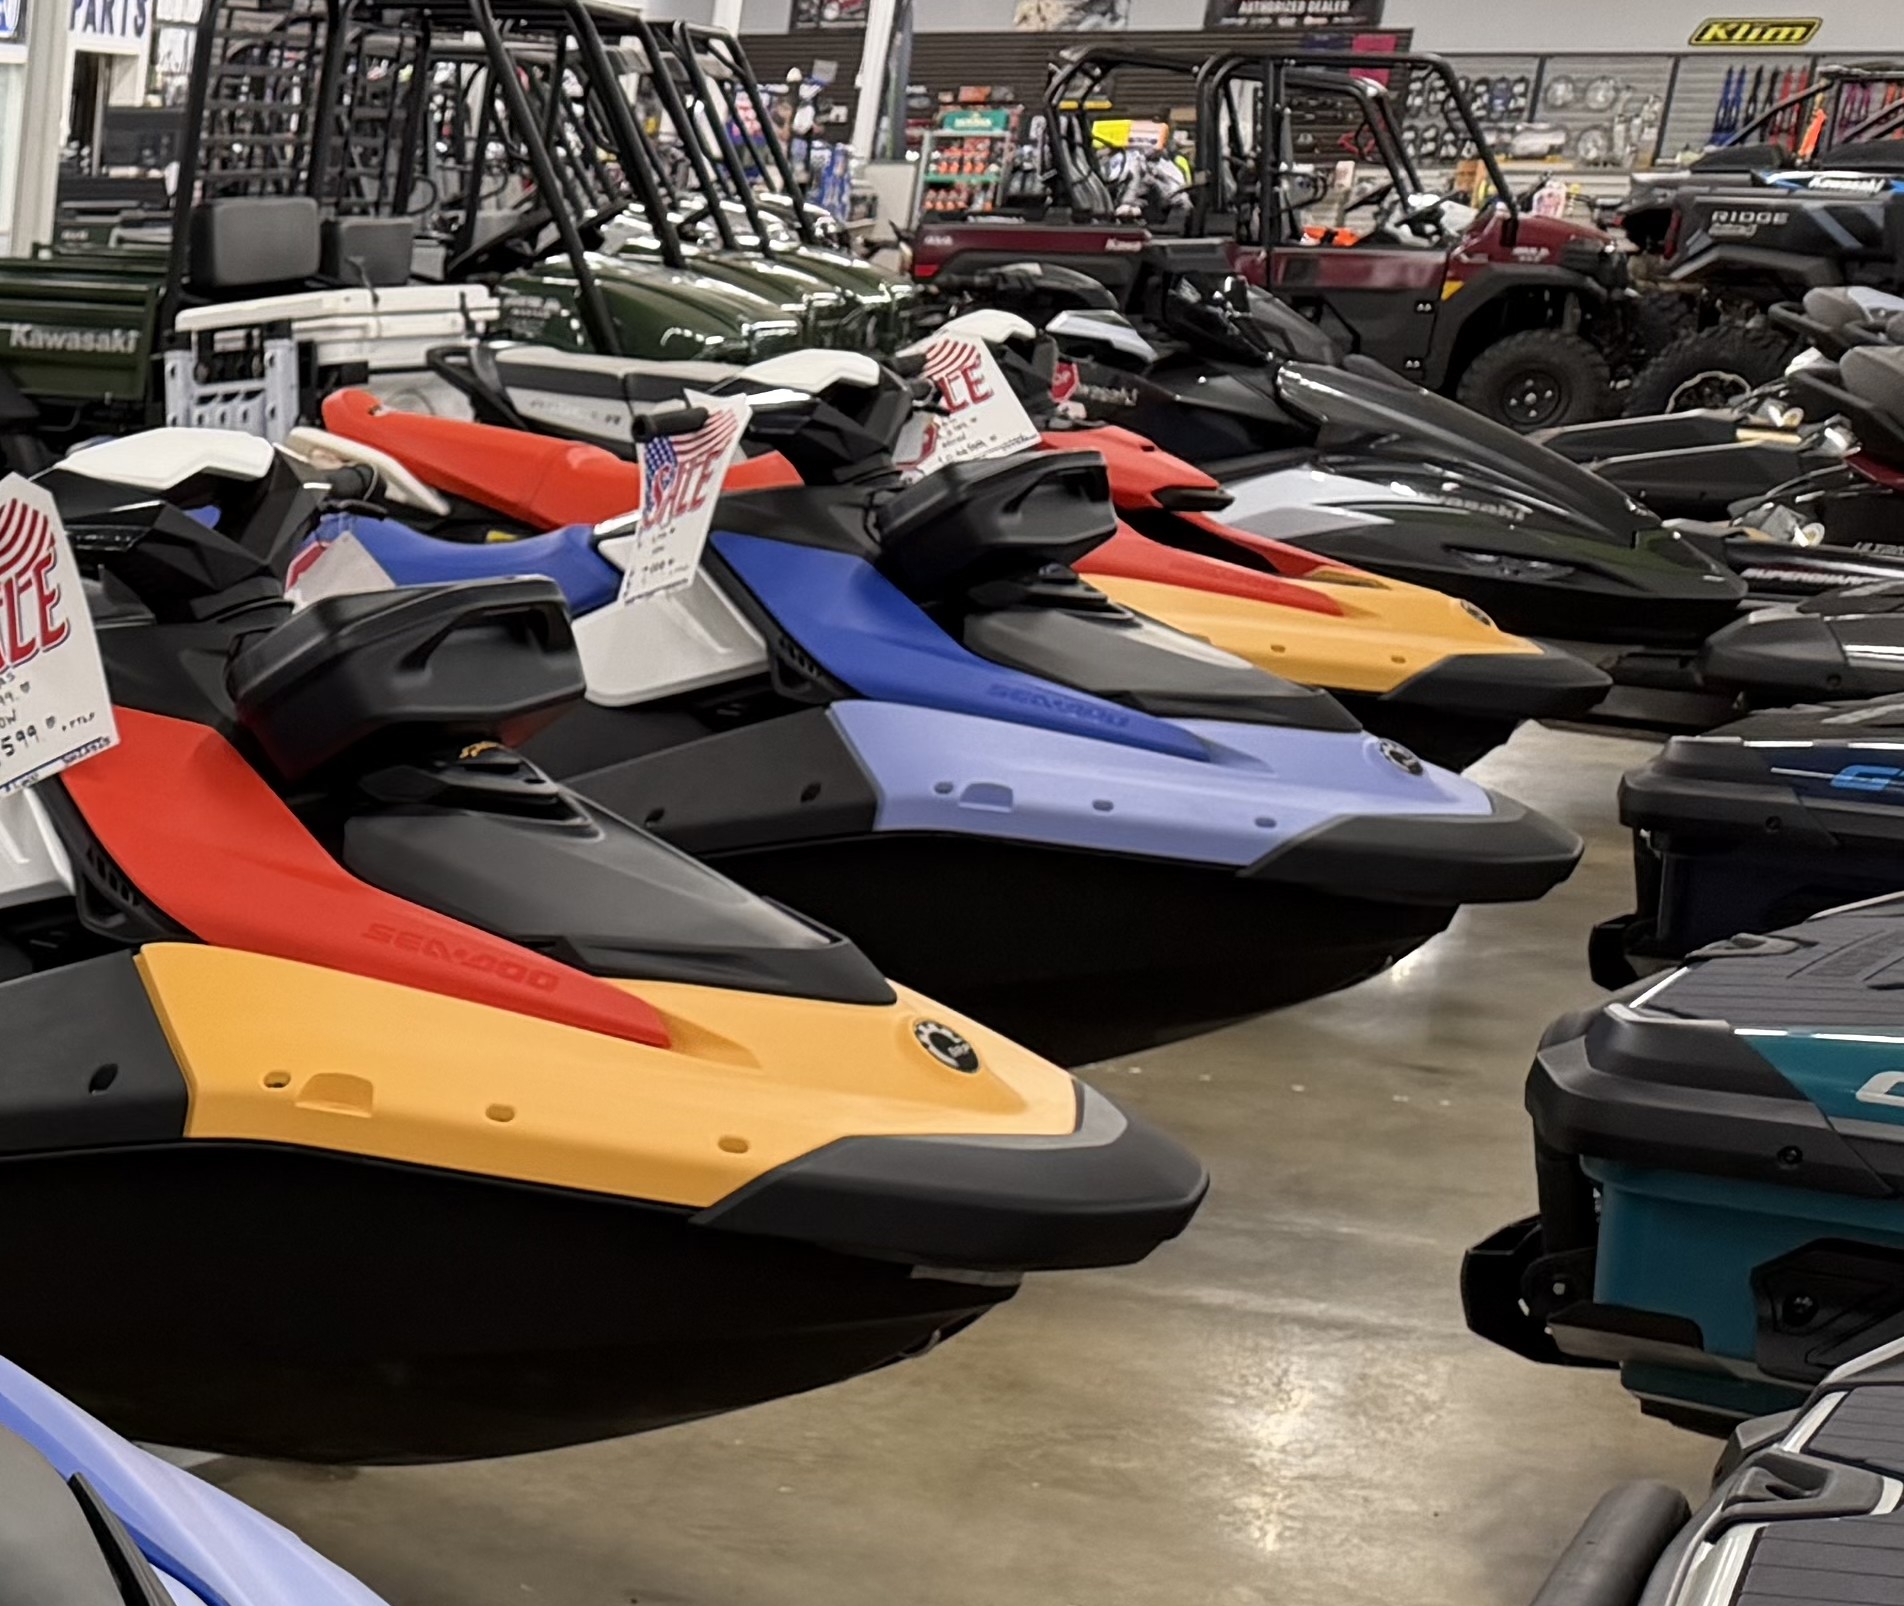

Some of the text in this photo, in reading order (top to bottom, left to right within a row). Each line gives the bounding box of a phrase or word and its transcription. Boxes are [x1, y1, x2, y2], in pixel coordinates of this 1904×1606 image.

[1700, 22, 1807, 42] Klim
[1711, 210, 1790, 225] RIDGE
[8, 323, 143, 354] Kawasaki
